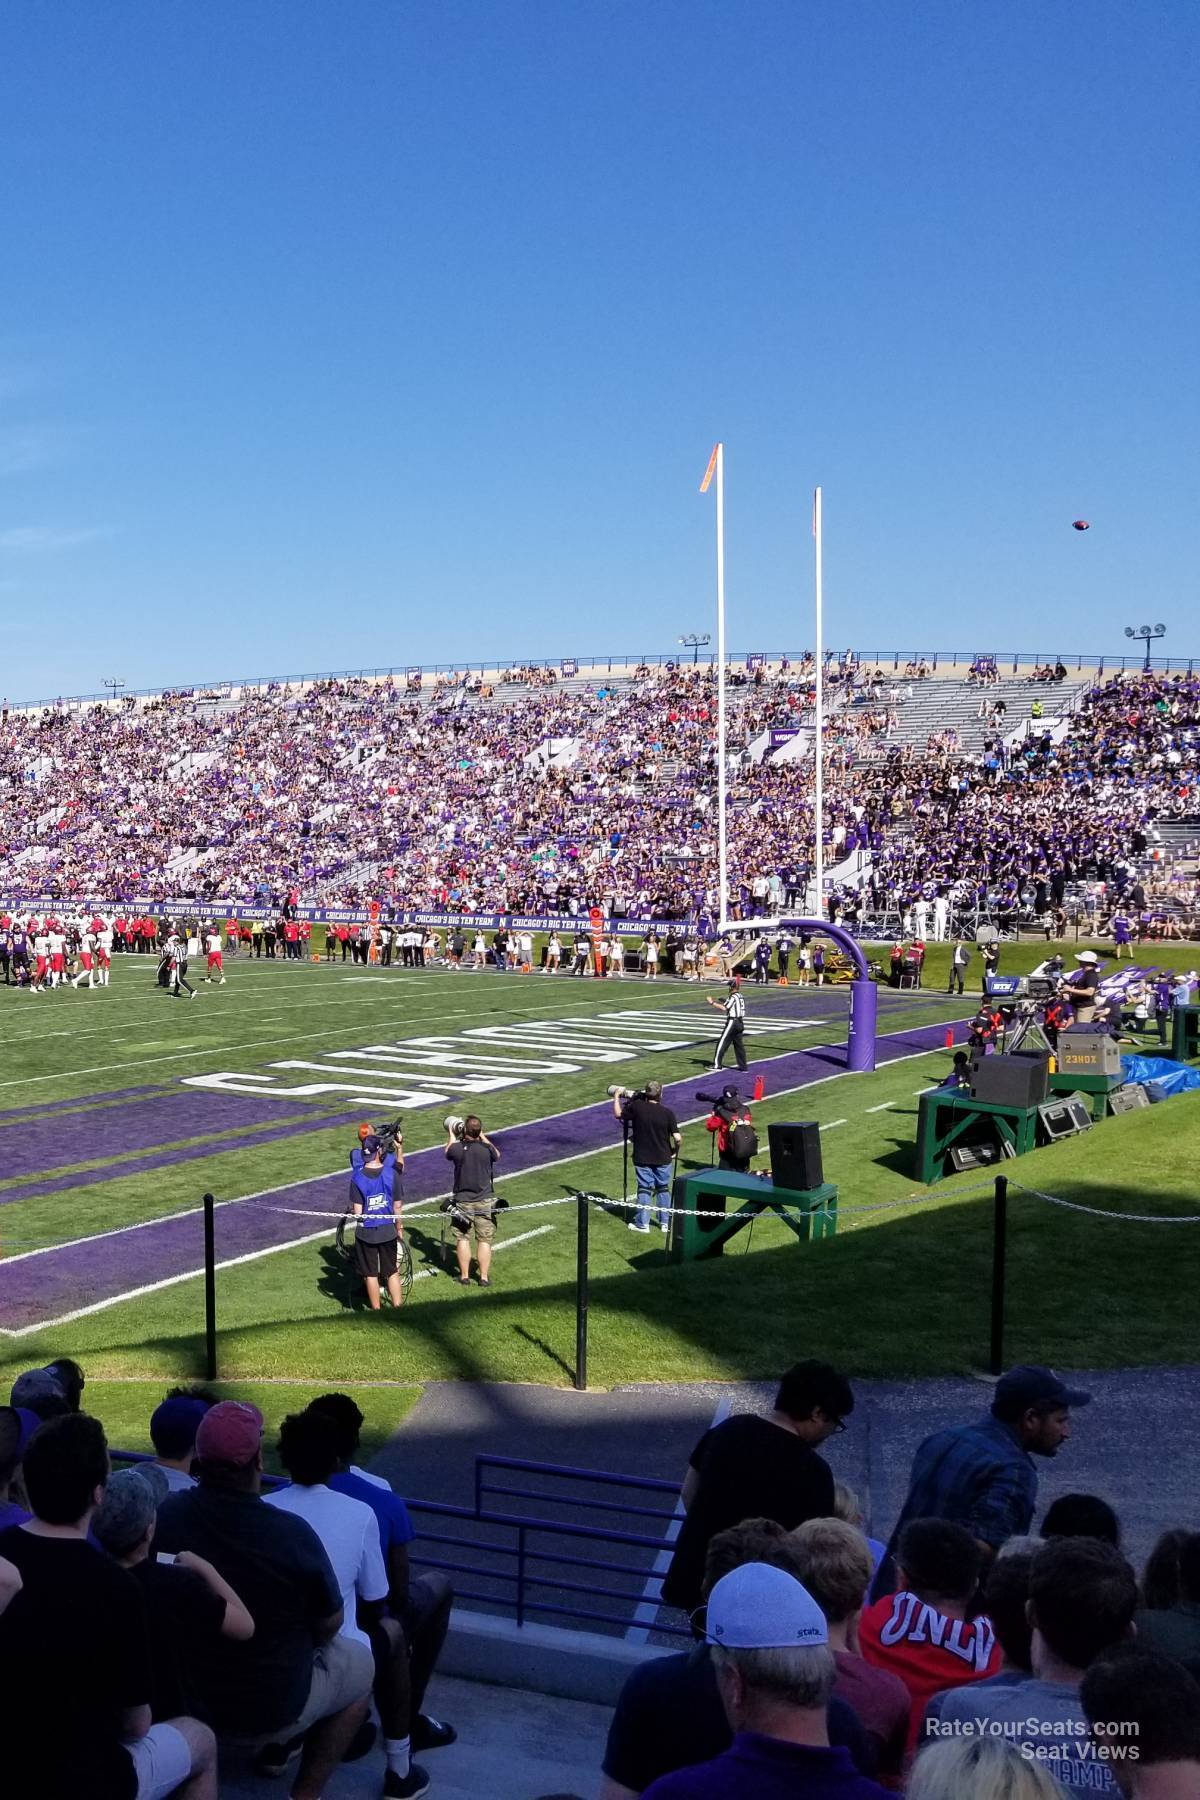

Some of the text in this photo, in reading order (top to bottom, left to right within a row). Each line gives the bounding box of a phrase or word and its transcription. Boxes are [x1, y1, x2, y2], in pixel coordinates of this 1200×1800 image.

[163, 906, 189, 914] CHICAGO'S
[189, 906, 200, 914] BIG
[201, 907, 211, 915] TEN
[212, 907, 227, 916] TEAM
[326, 911, 355, 920] CHICAGO'S
[355, 912, 367, 921] BIG
[415, 914, 448, 924] CHICAGO'S
[448, 915, 459, 924] BIG
[460, 916, 474, 925] TEN
[475, 917, 494, 926] TEAM
[512, 917, 547, 927] CHICAGO'S
[548, 919, 560, 928] BIG
[561, 920, 576, 929] TEN
[618, 922, 655, 932] CHICAGO'S
[656, 924, 669, 933] BIG
[673, 924, 686, 933] TEN
[688, 925, 698, 934] TE
[880, 1591, 996, 1673] UNLV
